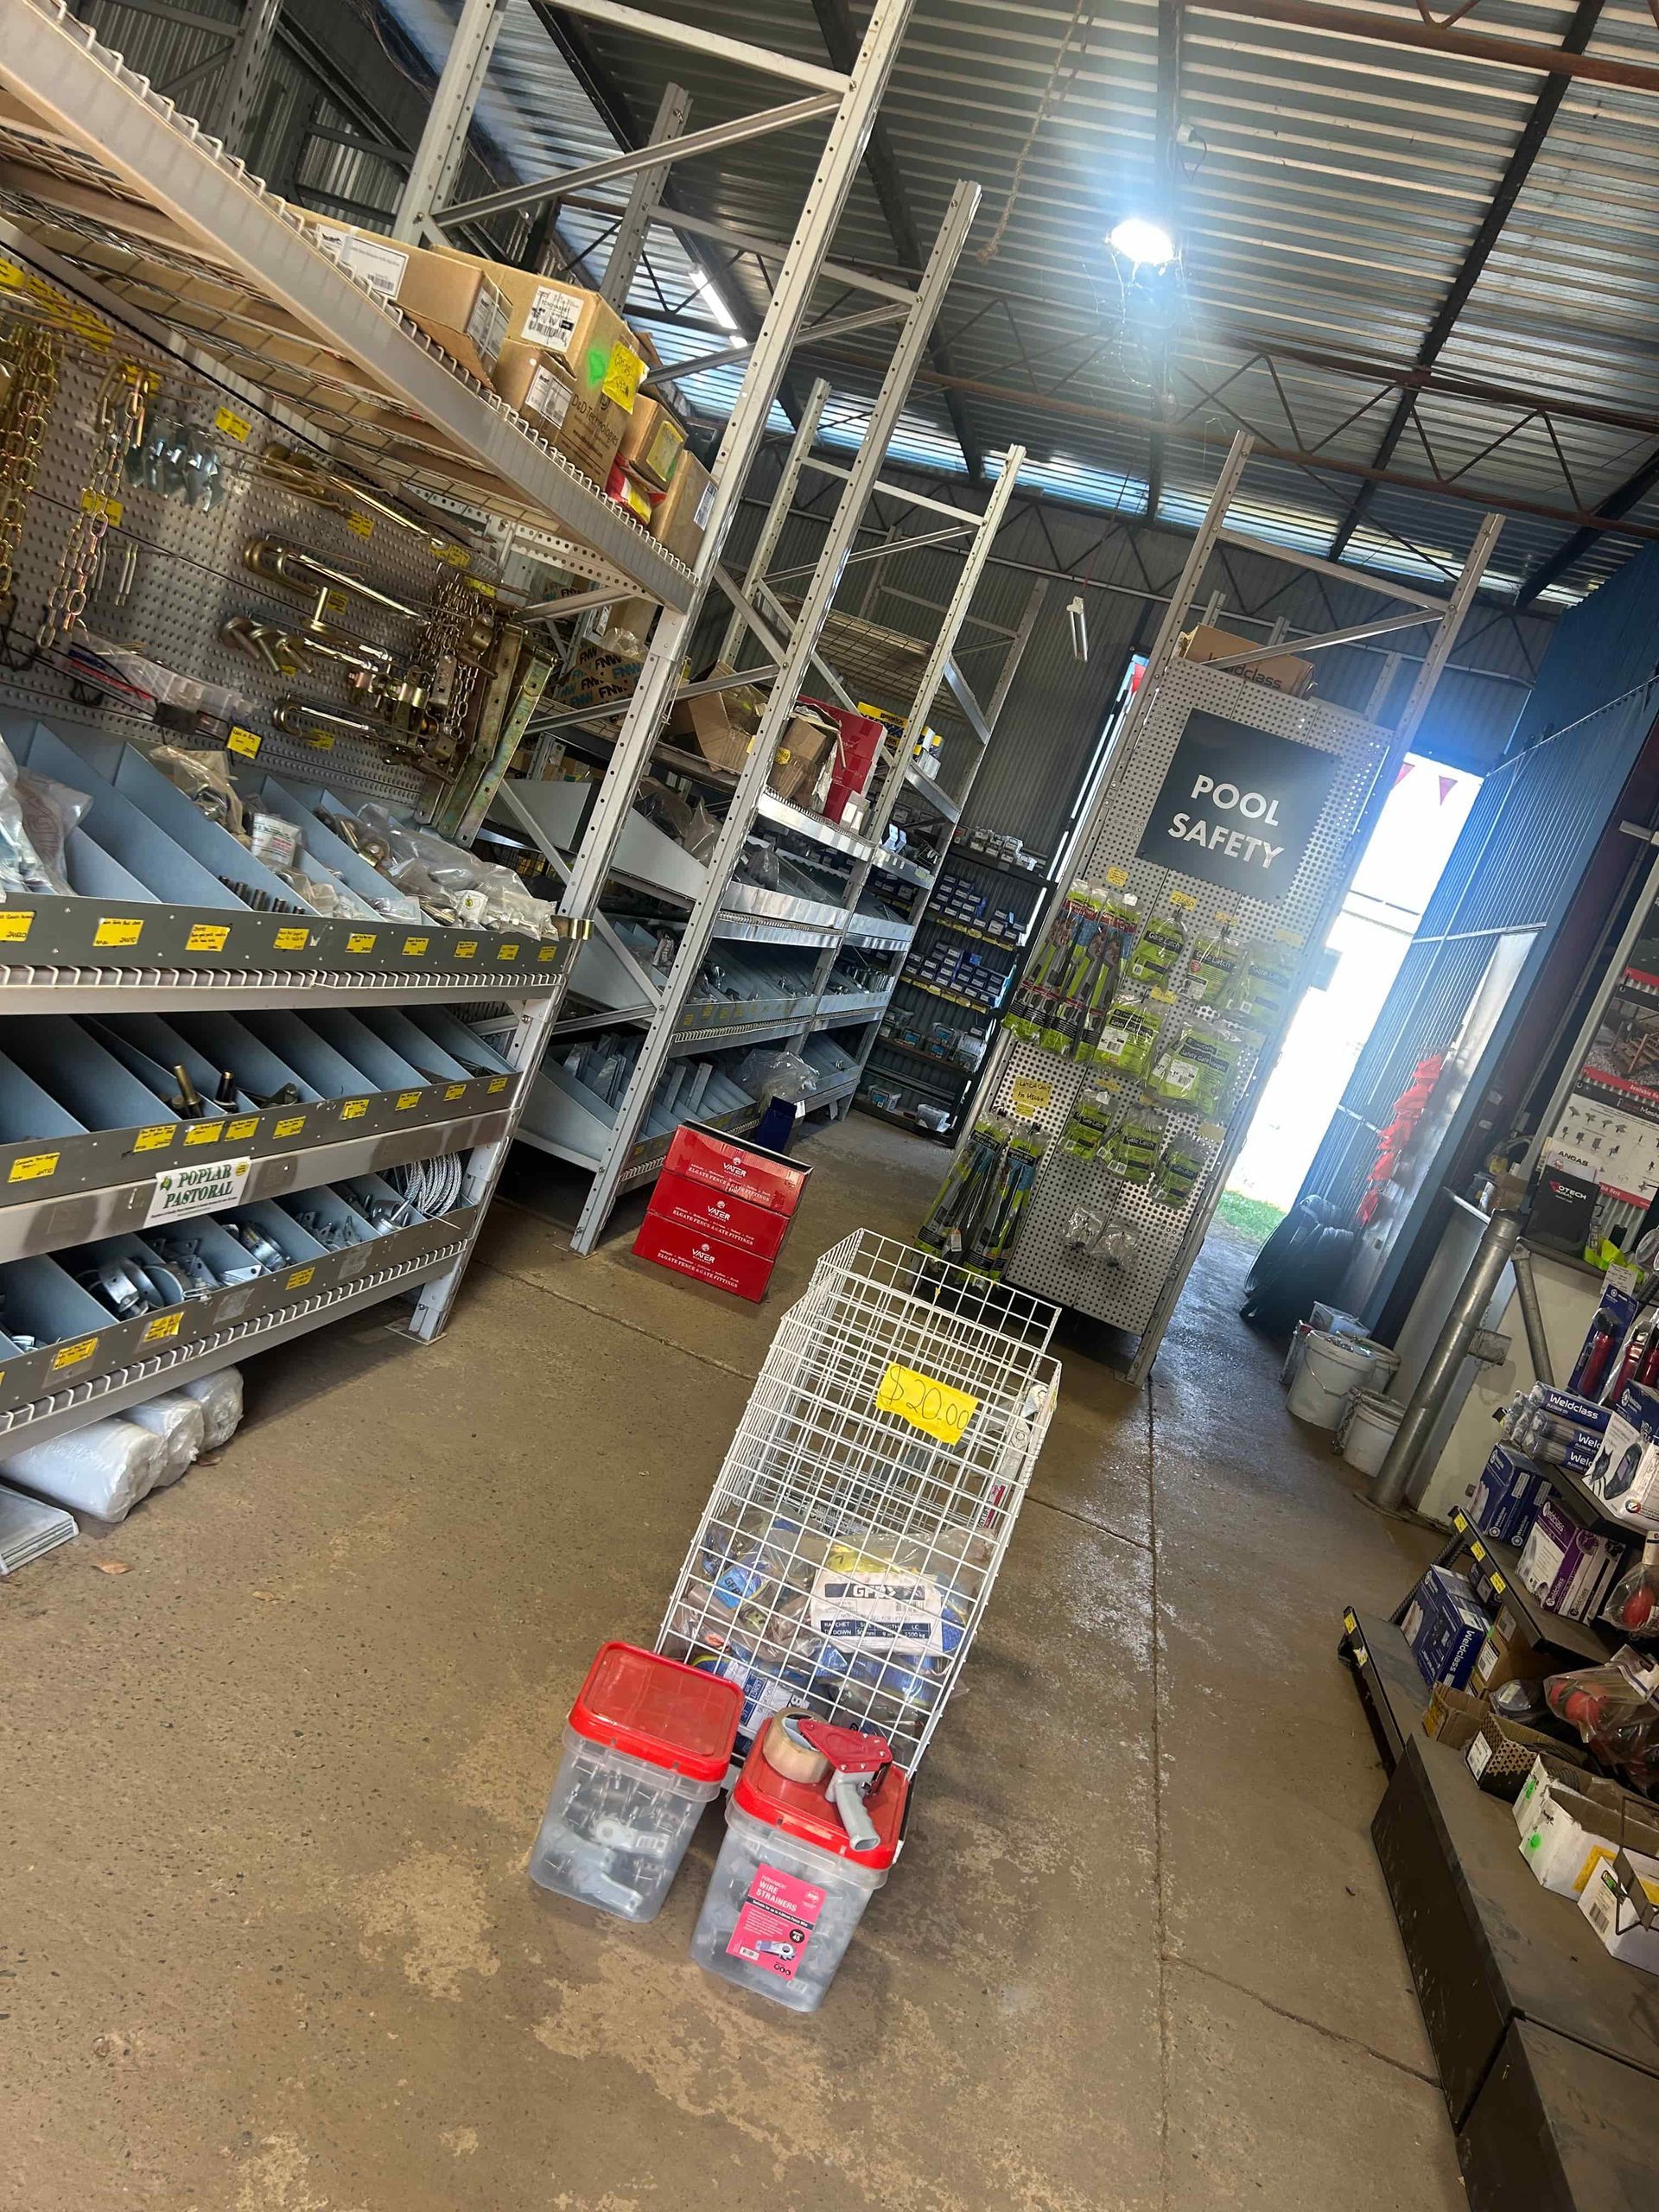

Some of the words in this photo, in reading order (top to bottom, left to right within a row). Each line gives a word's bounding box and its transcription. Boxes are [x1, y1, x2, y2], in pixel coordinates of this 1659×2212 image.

[1191, 774, 1280, 827] POOL
[1168, 813, 1284, 868] SAFETY
[1148, 931, 1163, 942] Gate
[1163, 937, 1179, 950] Latch
[1197, 950, 1211, 963] Gate
[1212, 955, 1230, 969] Latch
[1252, 964, 1267, 976] Gate
[1268, 969, 1286, 982] Latch
[1182, 1048, 1198, 1060] Safety
[1140, 1139, 1154, 1147] Latch
[1558, 1151, 1588, 1166] ANGAS
[177, 1164, 232, 1188] POPLAR
[723, 1163, 747, 1177] VATER
[688, 1166, 709, 1179] ELGATE
[709, 1175, 727, 1185] FENCE
[745, 1190, 769, 1201] FITTINGS
[163, 1181, 234, 1209] PASTORAL
[707, 1206, 730, 1220] VATER
[672, 1210, 694, 1221] ELGATE
[694, 1217, 710, 1228] FENCE
[729, 1233, 753, 1244] FITTINGS
[691, 1249, 715, 1262] VATER
[658, 1253, 678, 1264] ELGATE
[678, 1261, 696, 1271] FENCE
[714, 1276, 737, 1287] FITTINGS
[1550, 1394, 1599, 1420] Weldclass
[1450, 1630, 1475, 1672] Weldclass
[758, 1880, 779, 1895] WIRE
[756, 1889, 797, 1911] STRAINERS
